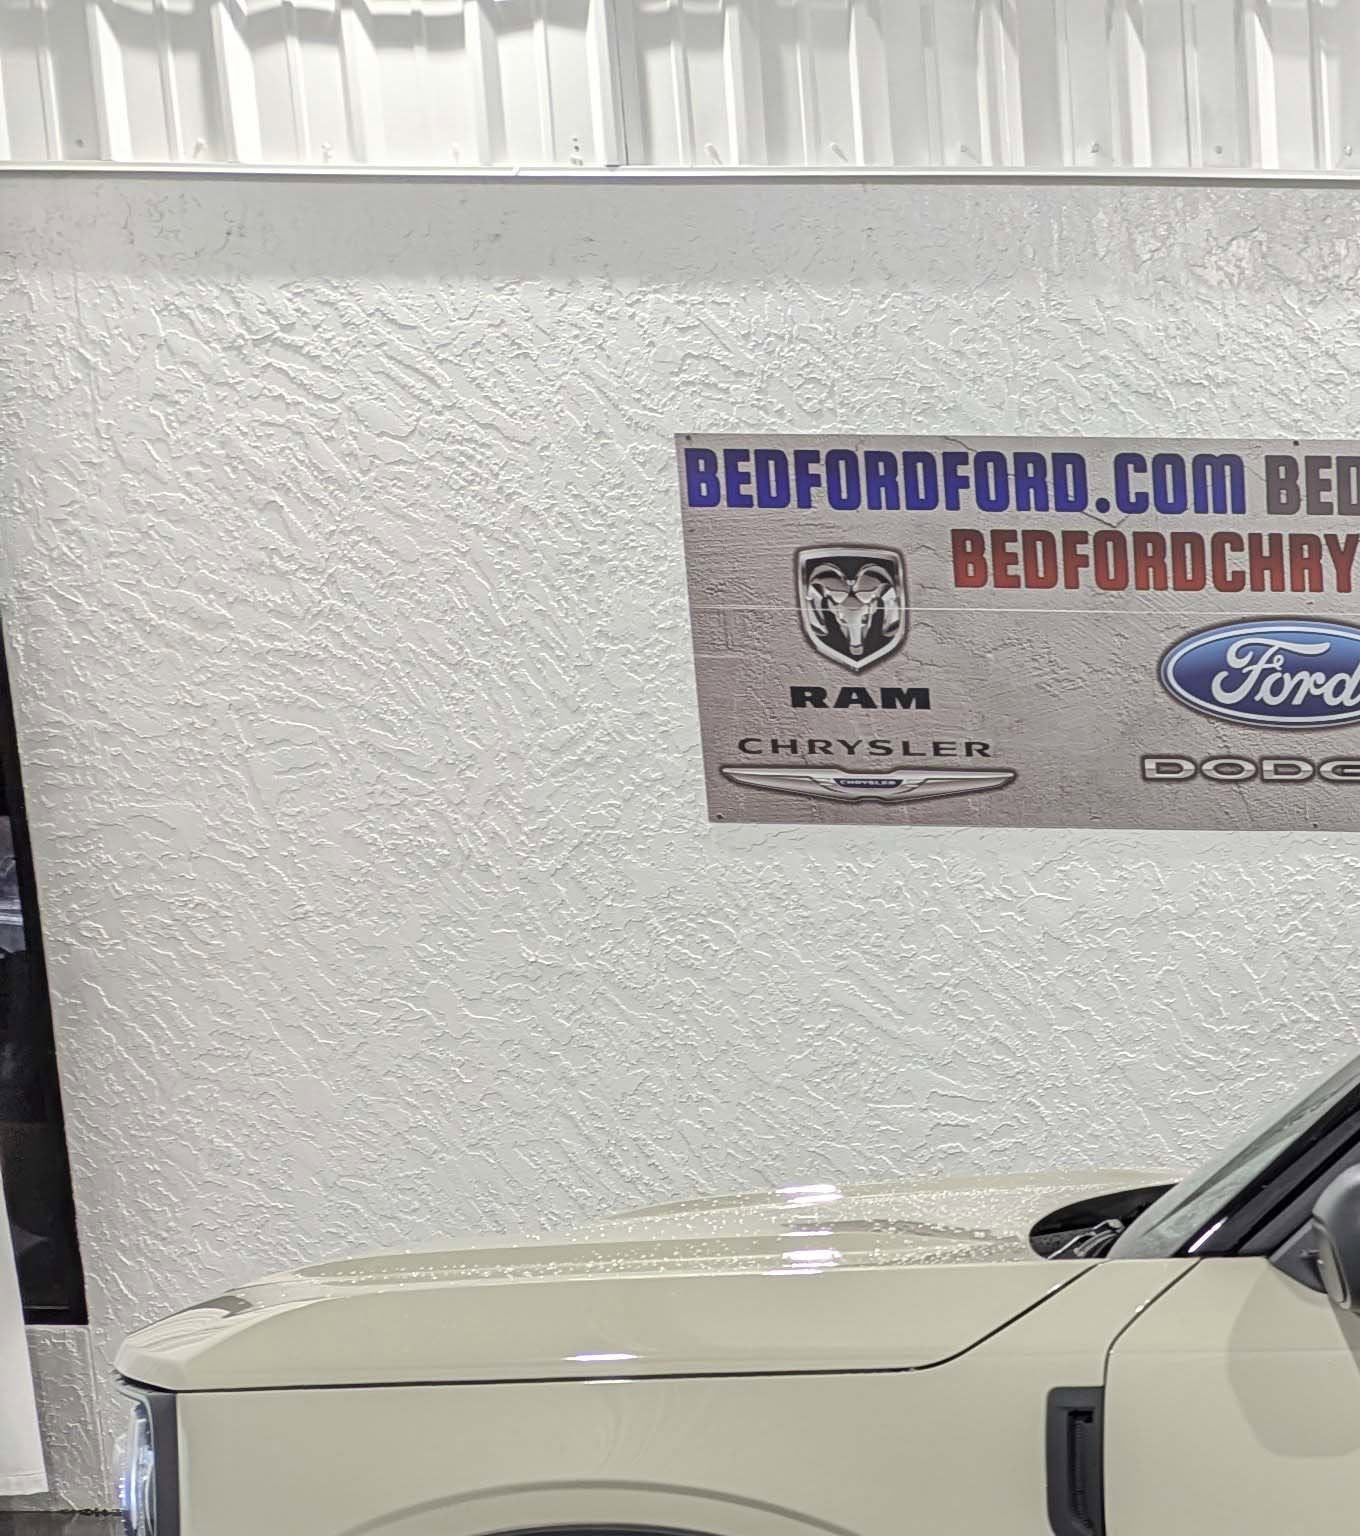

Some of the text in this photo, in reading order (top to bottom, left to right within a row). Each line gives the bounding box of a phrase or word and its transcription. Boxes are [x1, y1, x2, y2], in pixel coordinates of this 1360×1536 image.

[684, 447, 1246, 515] BEDFORDFORD.COM
[789, 686, 931, 711] RAM
[737, 736, 990, 758] CHRYSLER
